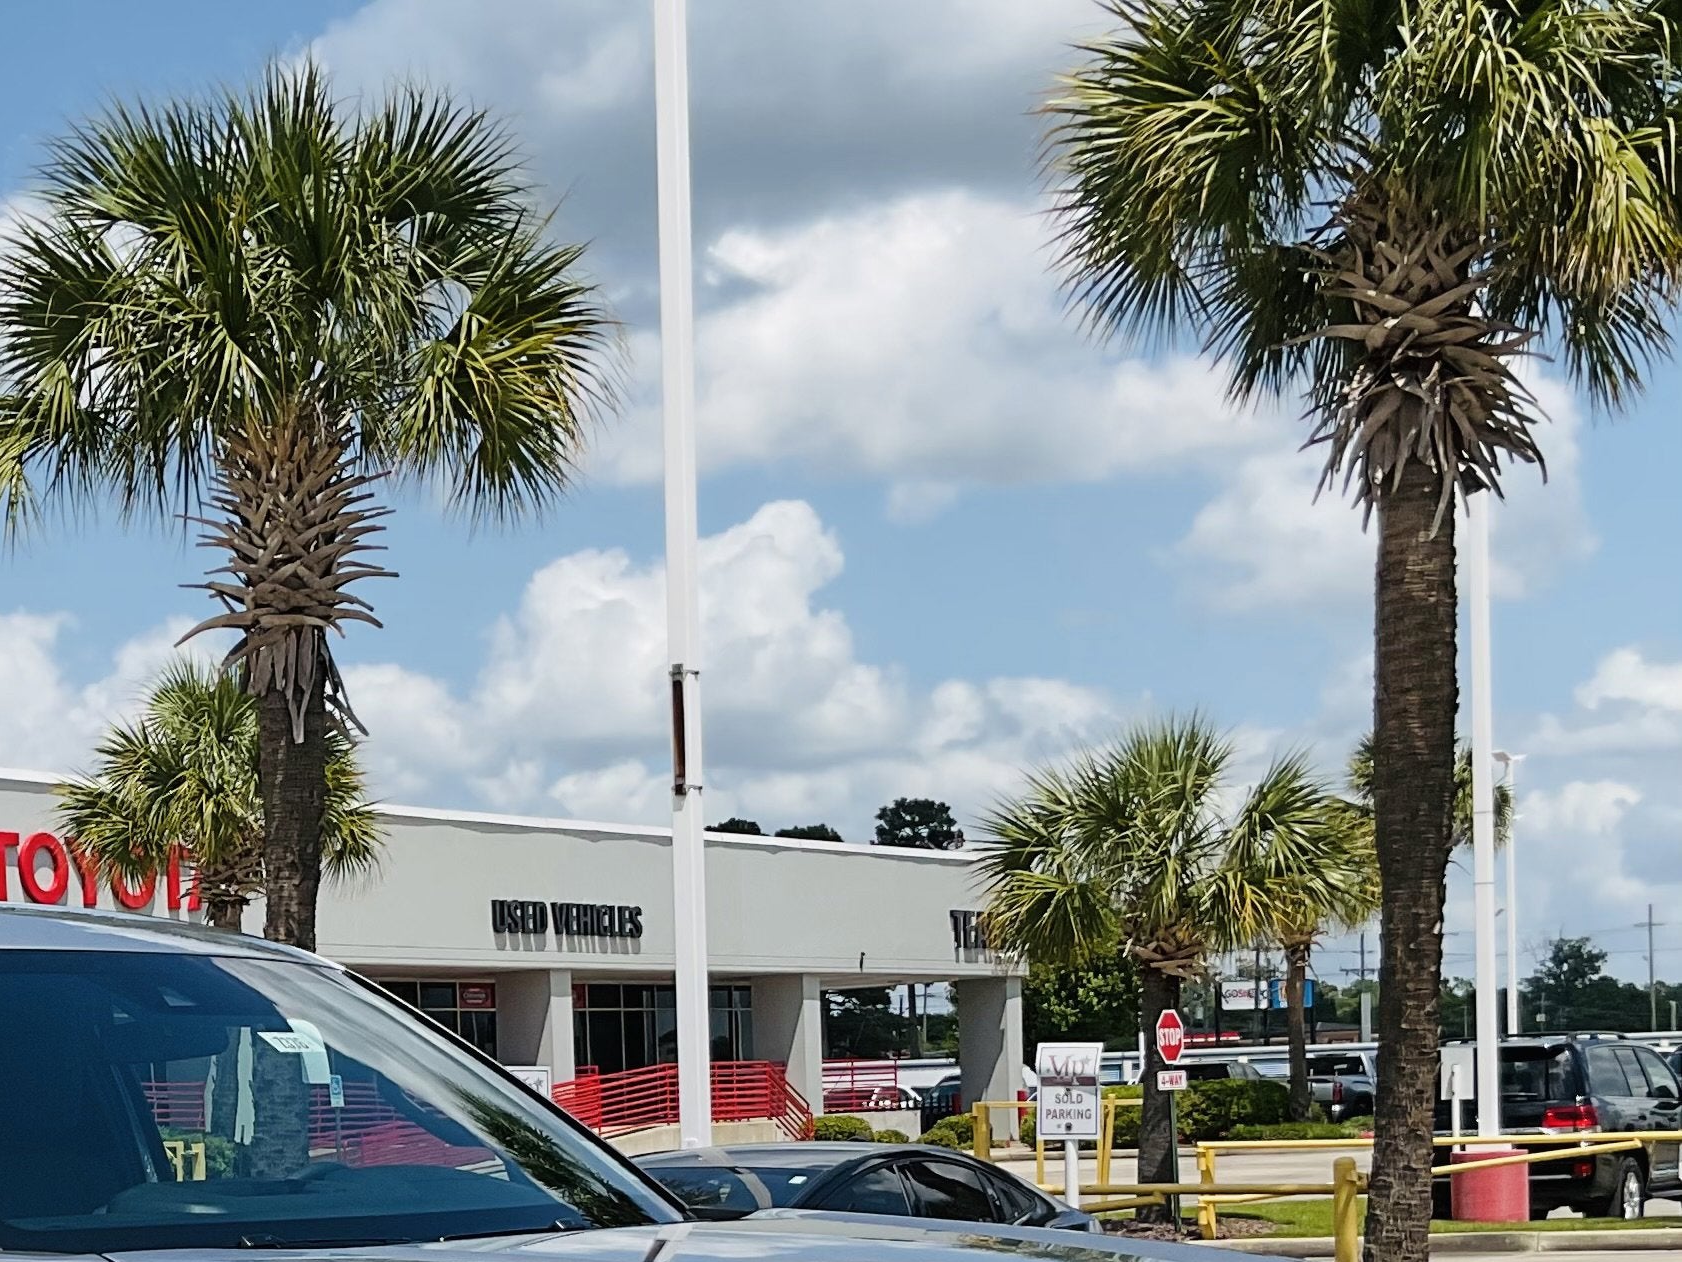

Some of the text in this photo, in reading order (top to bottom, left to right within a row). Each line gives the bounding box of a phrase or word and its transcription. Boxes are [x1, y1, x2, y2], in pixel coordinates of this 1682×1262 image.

[491, 899, 643, 938] USED VEHICLES
[1159, 1027, 1181, 1047] STOP
[1161, 1074, 1183, 1087] 4-WAY
[1054, 1093, 1083, 1105] SOLD
[1045, 1108, 1092, 1120] PARKING
